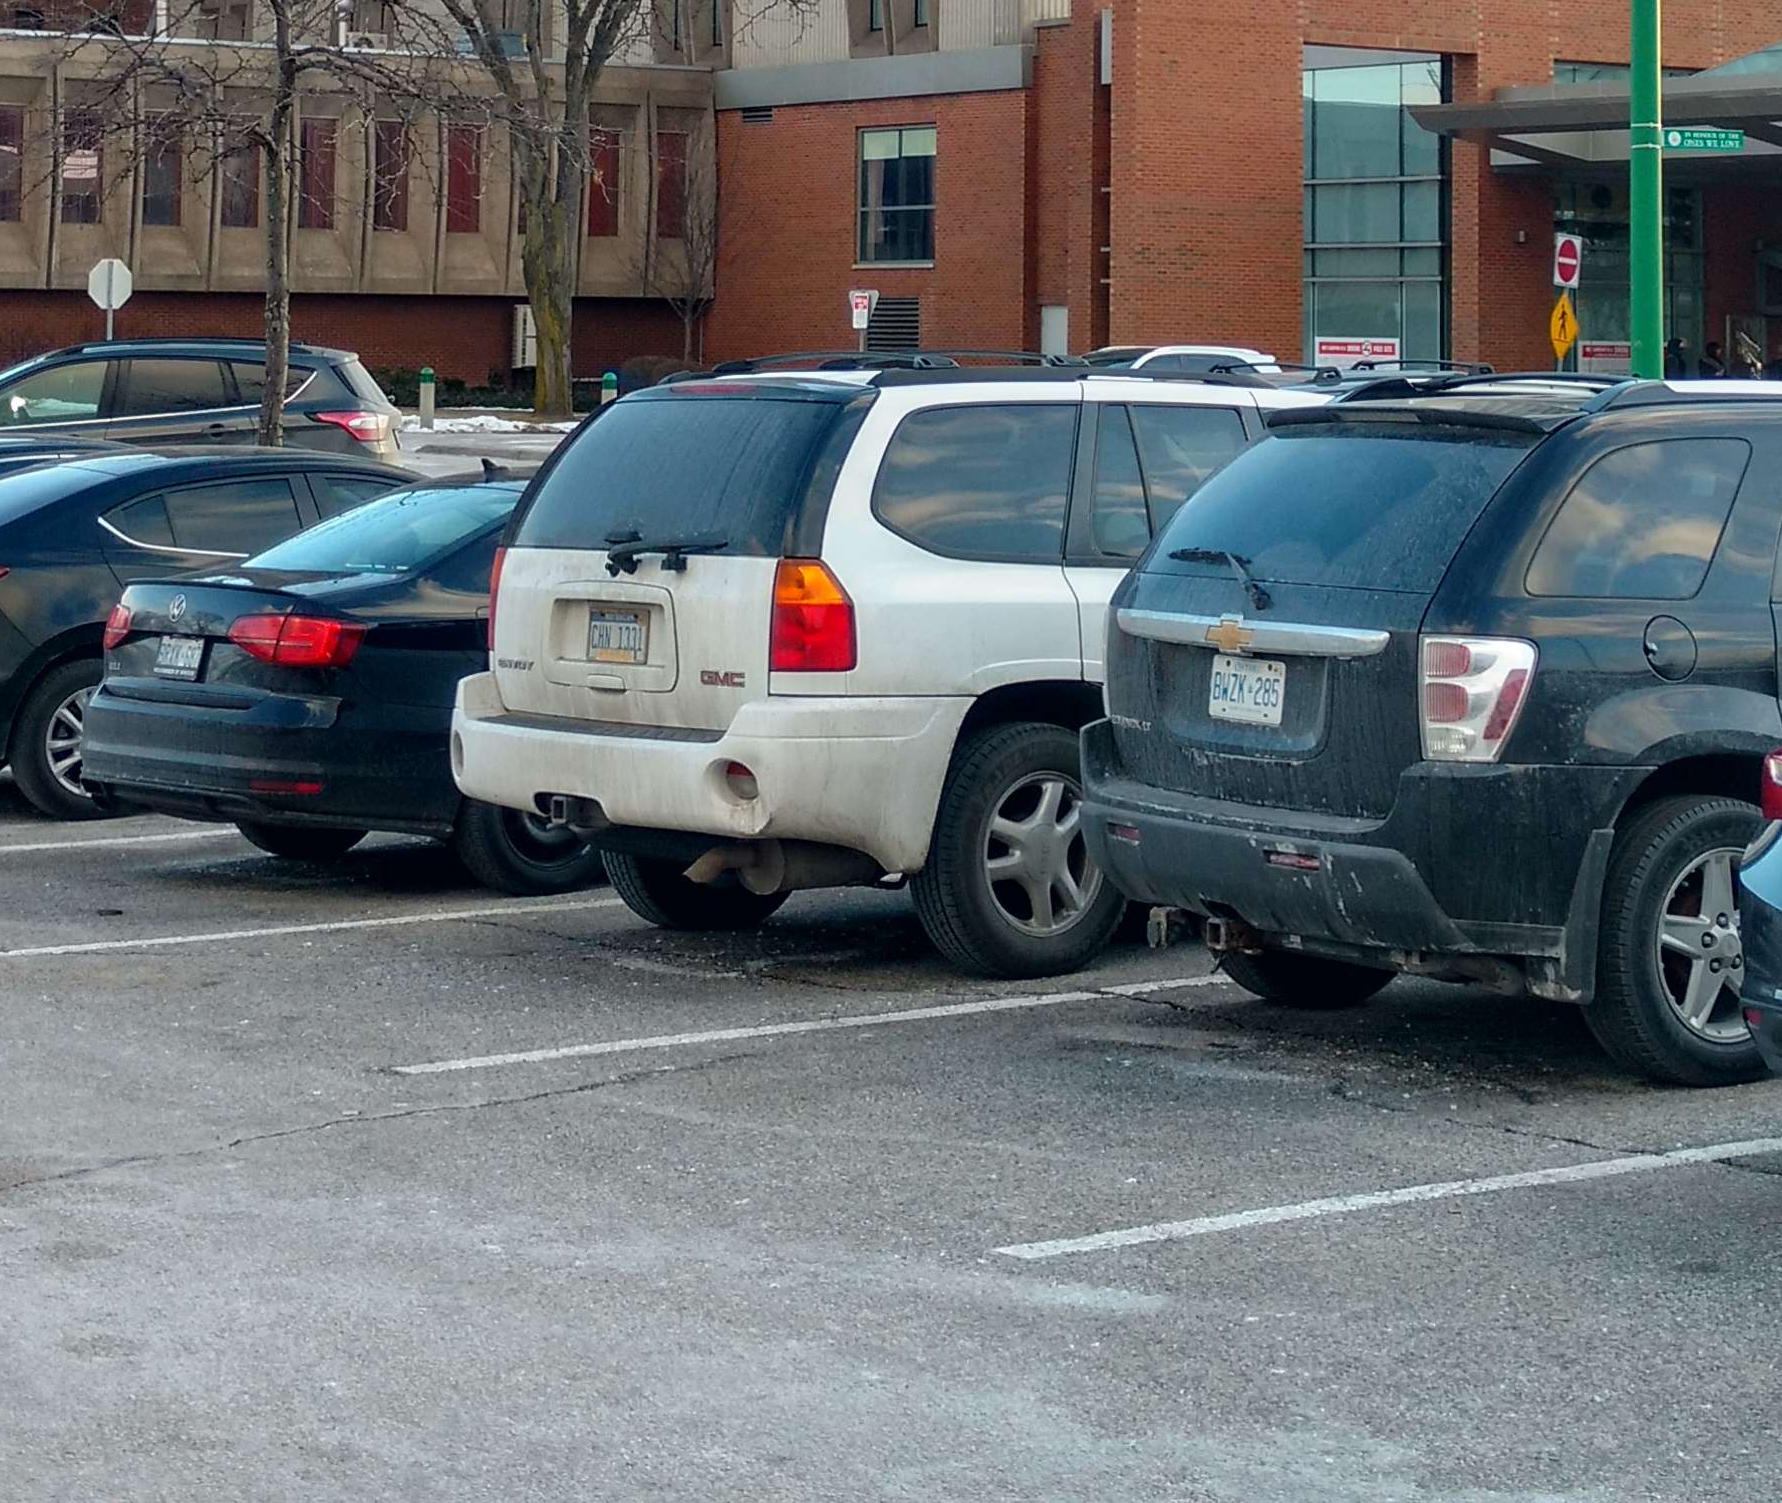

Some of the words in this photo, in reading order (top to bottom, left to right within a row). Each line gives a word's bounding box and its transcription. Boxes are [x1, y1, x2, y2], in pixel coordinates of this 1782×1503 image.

[700, 670, 745, 688] GMC
[1213, 671, 1246, 704] BWZK
[1254, 677, 1280, 708] 285
